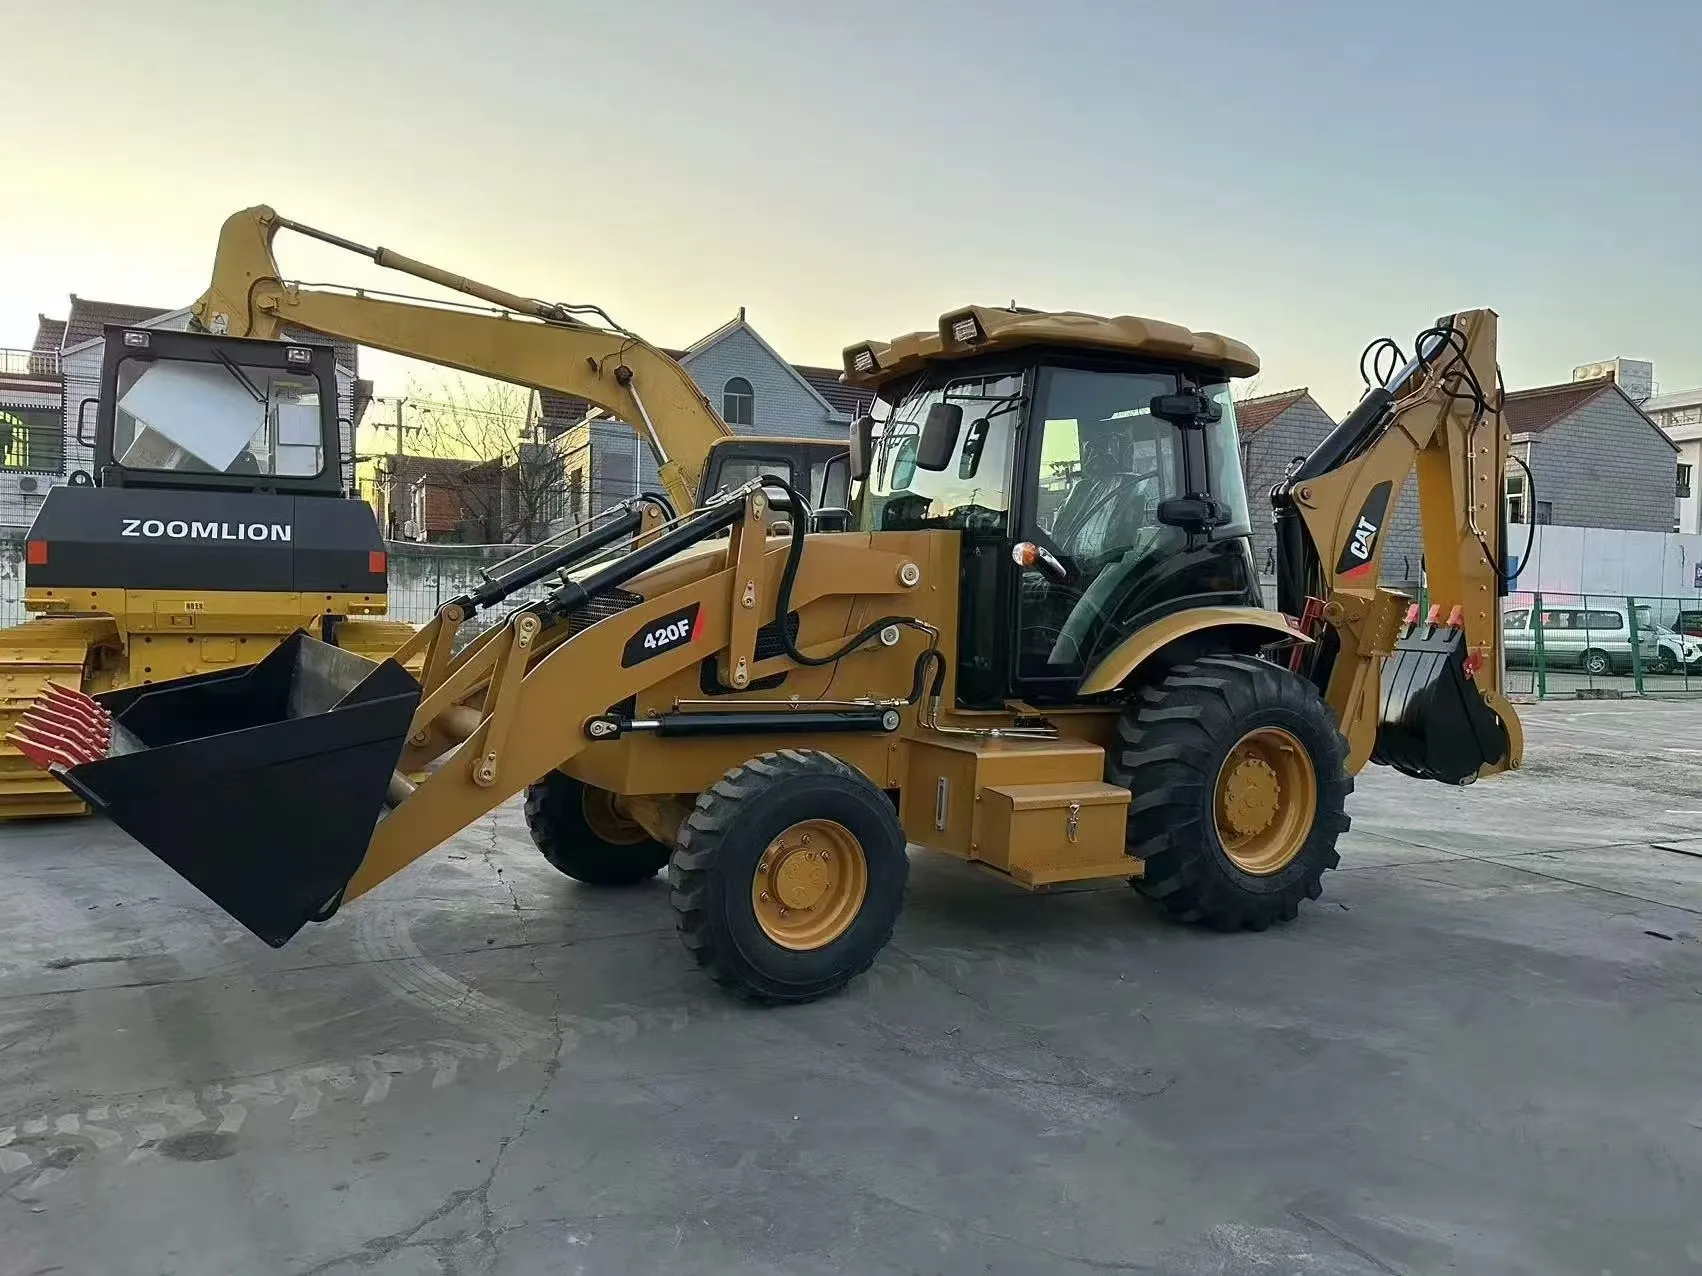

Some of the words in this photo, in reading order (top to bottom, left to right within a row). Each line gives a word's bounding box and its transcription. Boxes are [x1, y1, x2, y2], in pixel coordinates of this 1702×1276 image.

[121, 519, 291, 542] ZOOMLION
[1350, 515, 1377, 560] CAT
[643, 618, 690, 649] 420F
